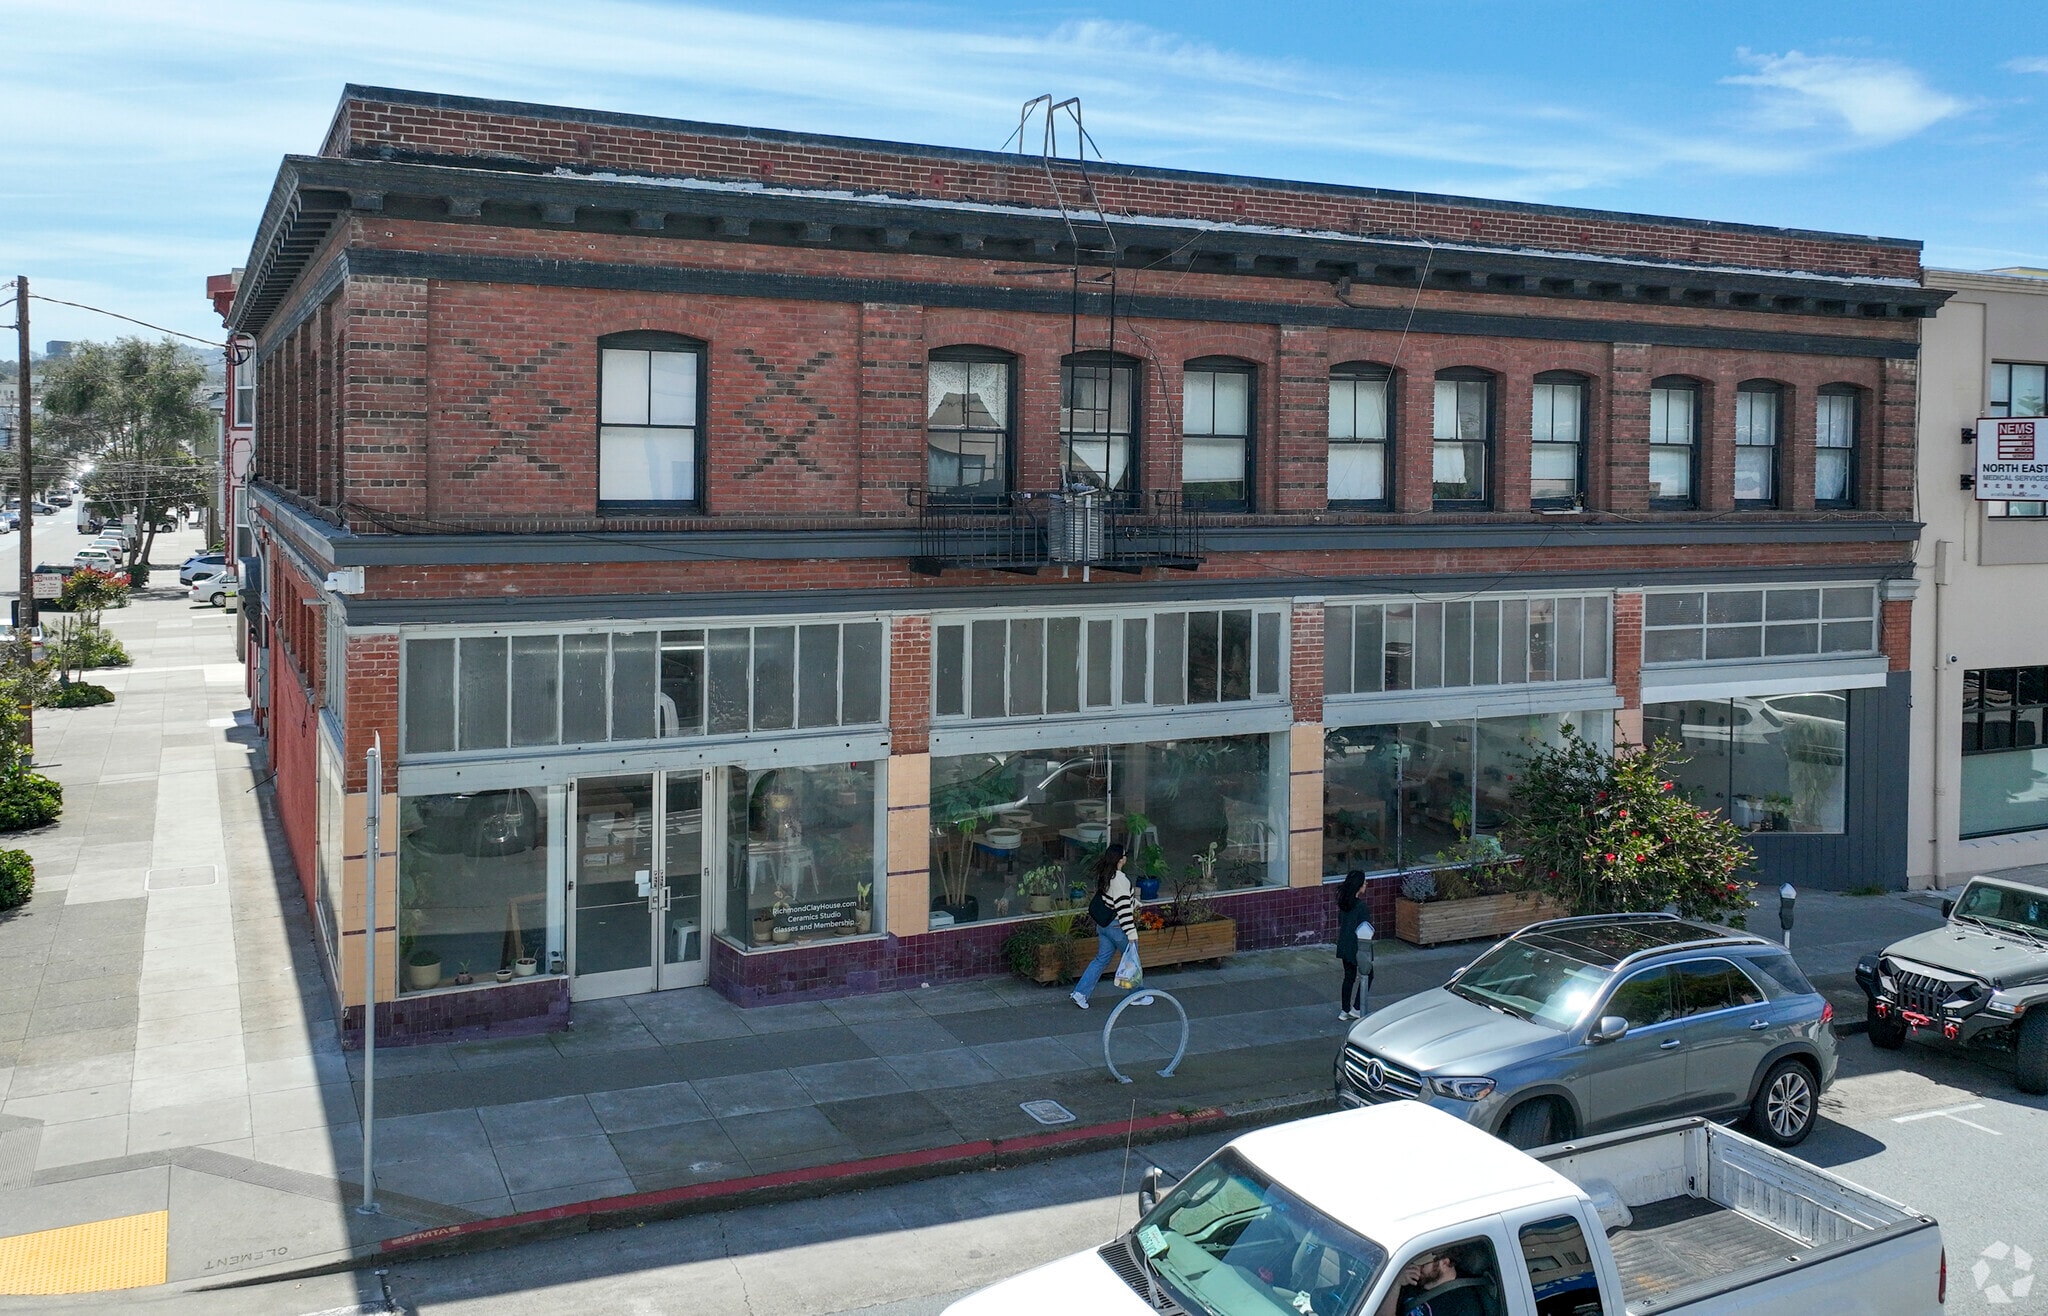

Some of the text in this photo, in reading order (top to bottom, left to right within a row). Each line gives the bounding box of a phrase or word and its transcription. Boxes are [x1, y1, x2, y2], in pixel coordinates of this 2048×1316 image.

[1999, 424, 2033, 434] NEMS
[1982, 463, 2048, 473] NORTH EAST
[773, 901, 856, 914] RichmondClayHouse.com
[788, 911, 841, 923] Ceramics Studio
[814, 919, 855, 929] Membership
[403, 1227, 449, 1243] SFMTA
[204, 1246, 288, 1269] CLEMENT
